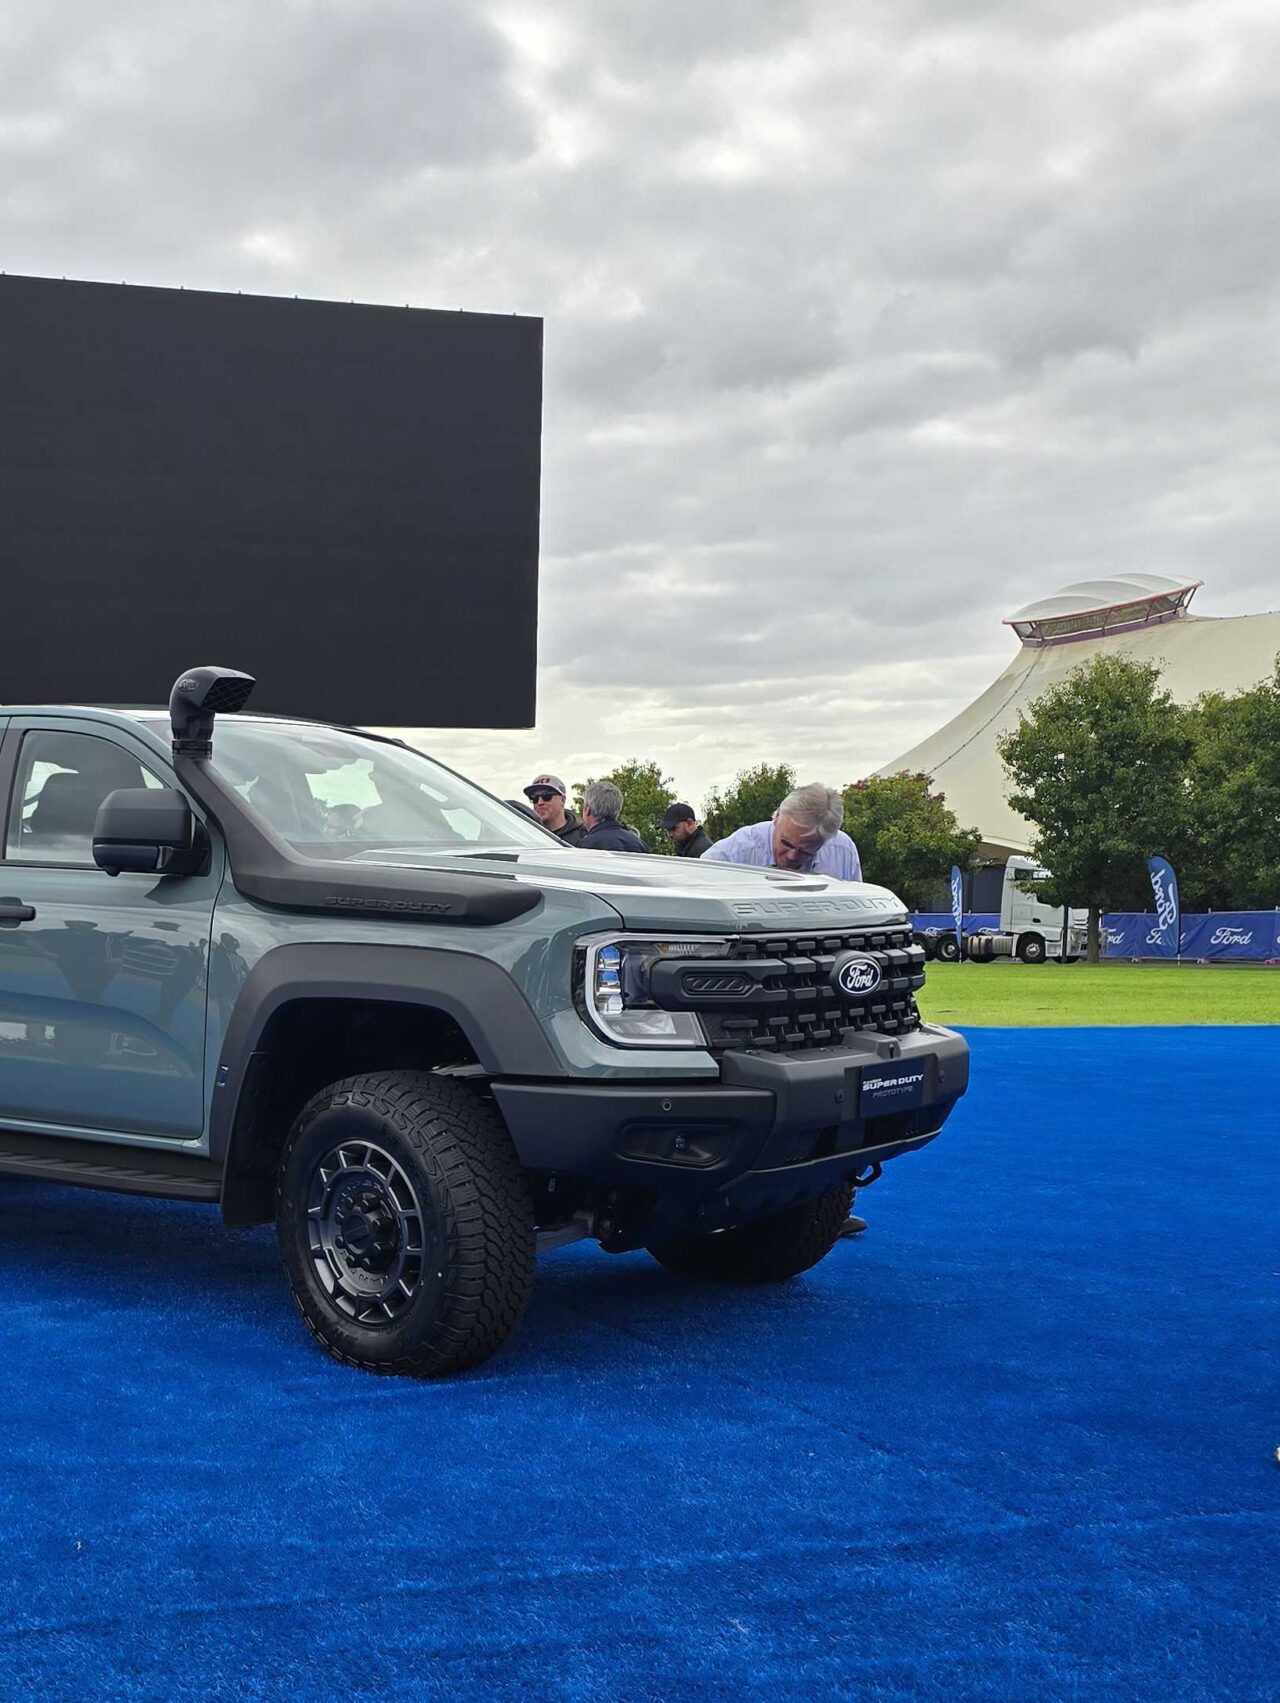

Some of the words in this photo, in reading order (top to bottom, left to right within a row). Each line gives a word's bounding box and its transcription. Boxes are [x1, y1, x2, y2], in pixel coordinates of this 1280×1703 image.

[324, 896, 391, 910] SUPER
[393, 901, 452, 912] DUTY
[732, 900, 840, 916] SUPER
[845, 896, 900, 910] DUTY
[1210, 927, 1253, 945] Ford
[846, 963, 873, 988] Ford
[862, 1079, 897, 1091] SUPER
[898, 1074, 924, 1085] DUTY
[872, 1086, 913, 1098] PROTOTYPE
